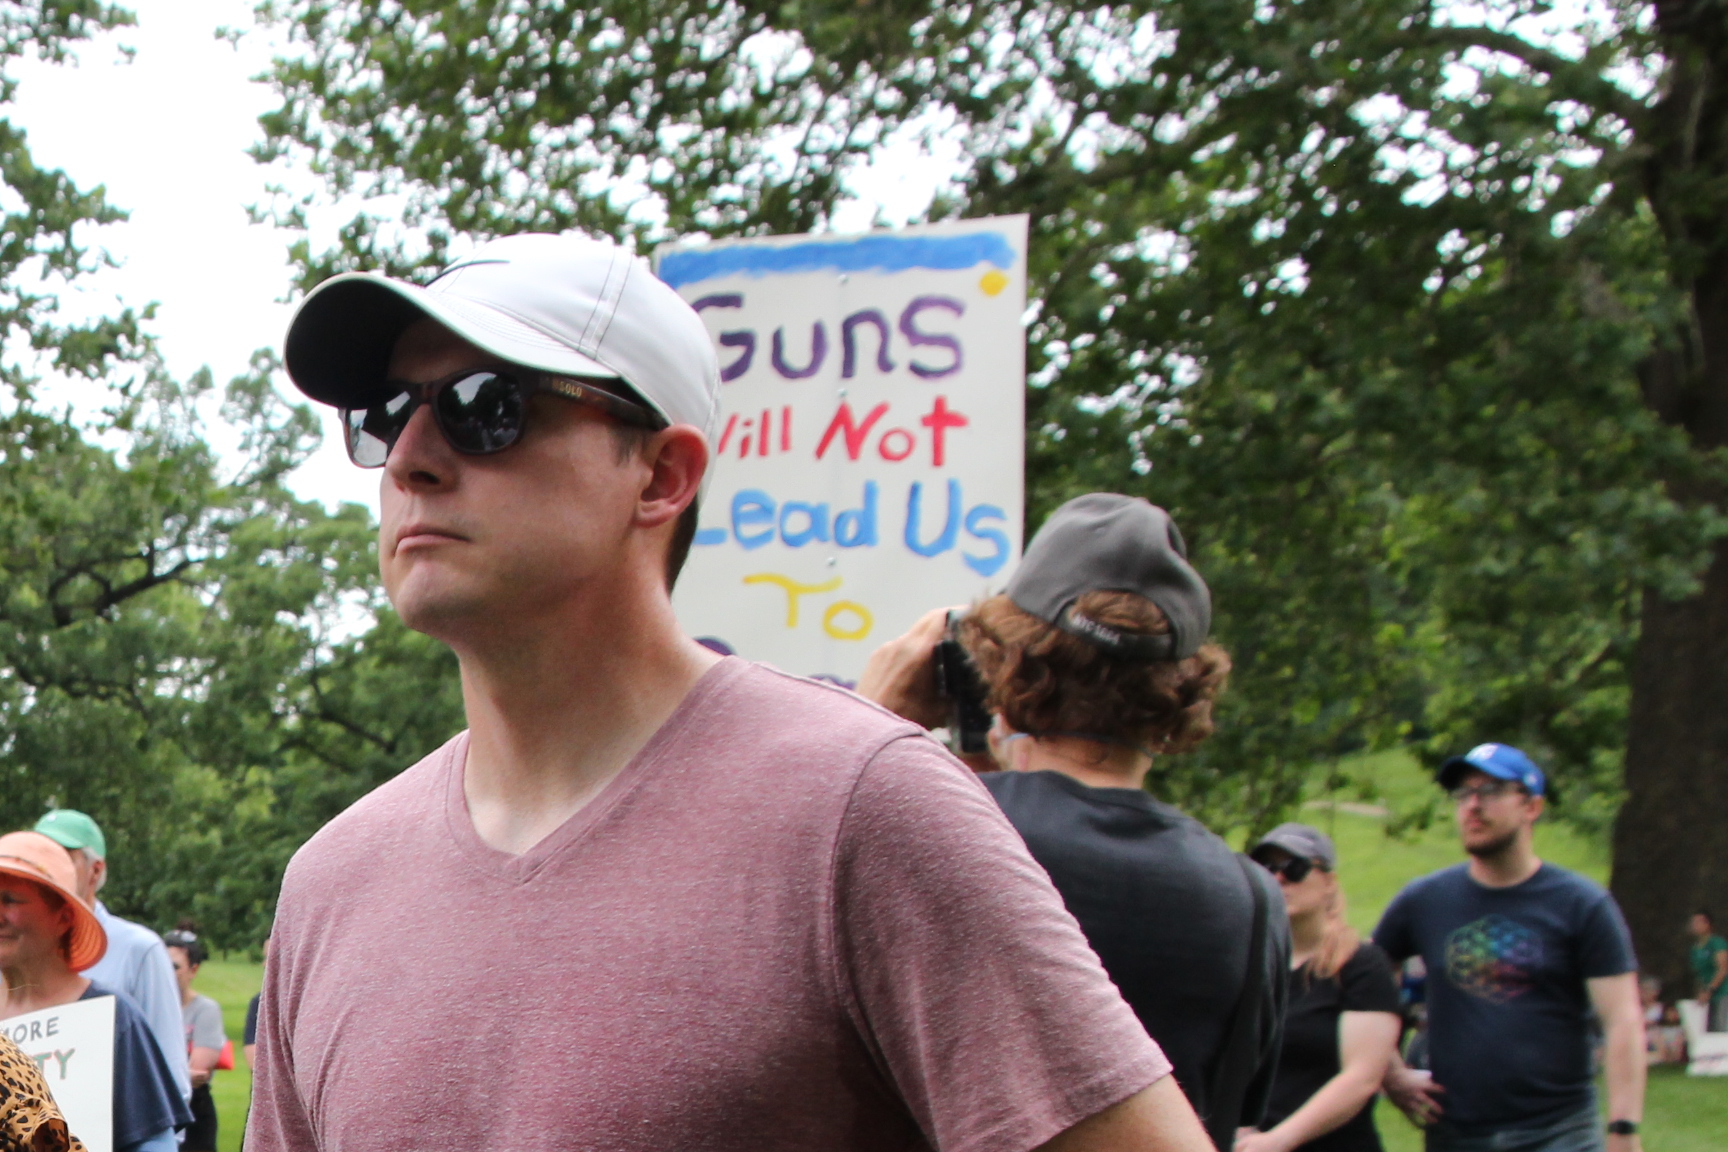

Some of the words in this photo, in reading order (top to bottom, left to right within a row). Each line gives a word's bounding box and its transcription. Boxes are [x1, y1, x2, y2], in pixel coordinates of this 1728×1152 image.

[718, 405, 793, 460] ill
[816, 396, 969, 467] Not
[905, 479, 1010, 577] Us
[741, 573, 873, 640] To
